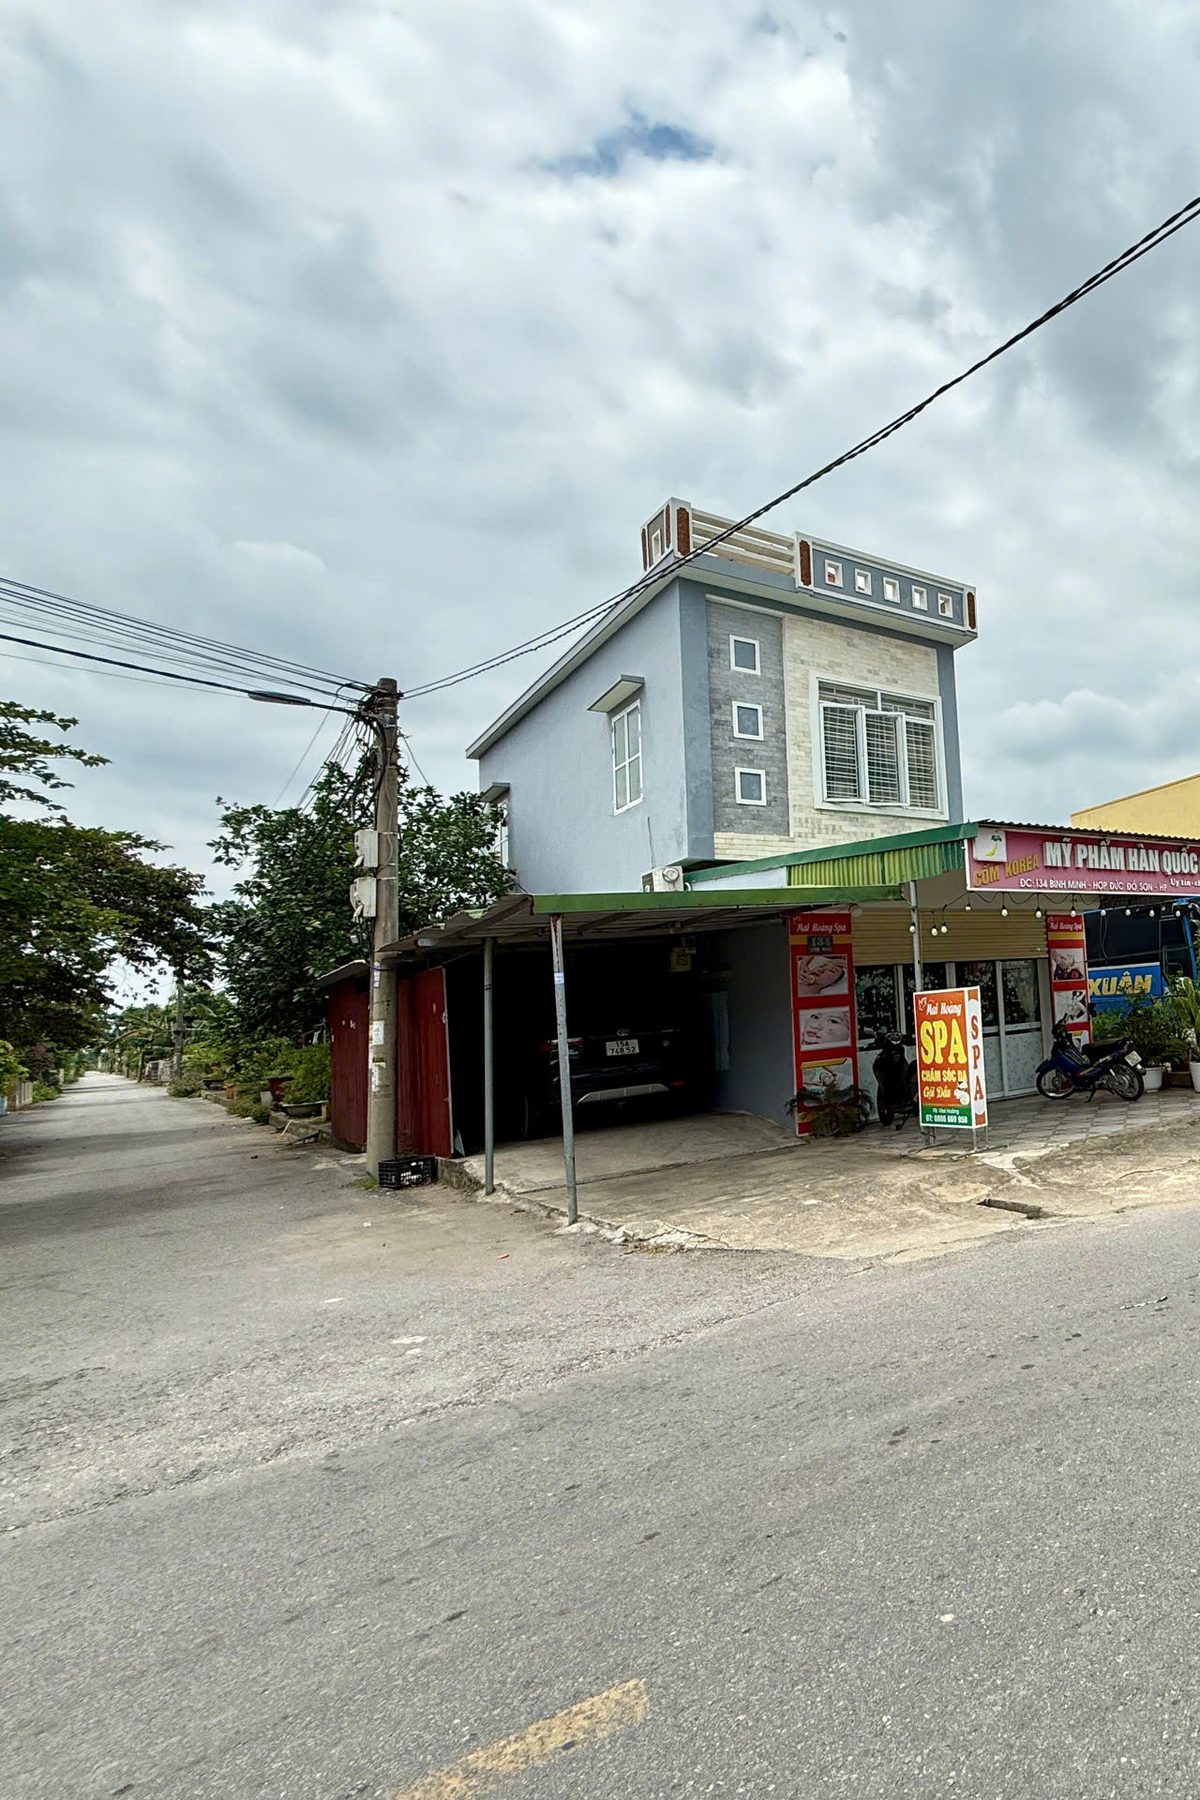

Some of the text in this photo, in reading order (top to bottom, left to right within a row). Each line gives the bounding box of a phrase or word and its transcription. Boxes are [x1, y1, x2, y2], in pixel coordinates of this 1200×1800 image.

[1005, 855, 1039, 877] KOREA
[1044, 837, 1072, 867] MỸ
[1075, 839, 1125, 871] PHẨM
[1126, 843, 1160, 872] HÀN
[1162, 845, 1199, 875] QUỐC
[1068, 880, 1086, 889] MINH
[1088, 971, 1152, 995] XUÂN
[920, 1018, 967, 1064] SPA
